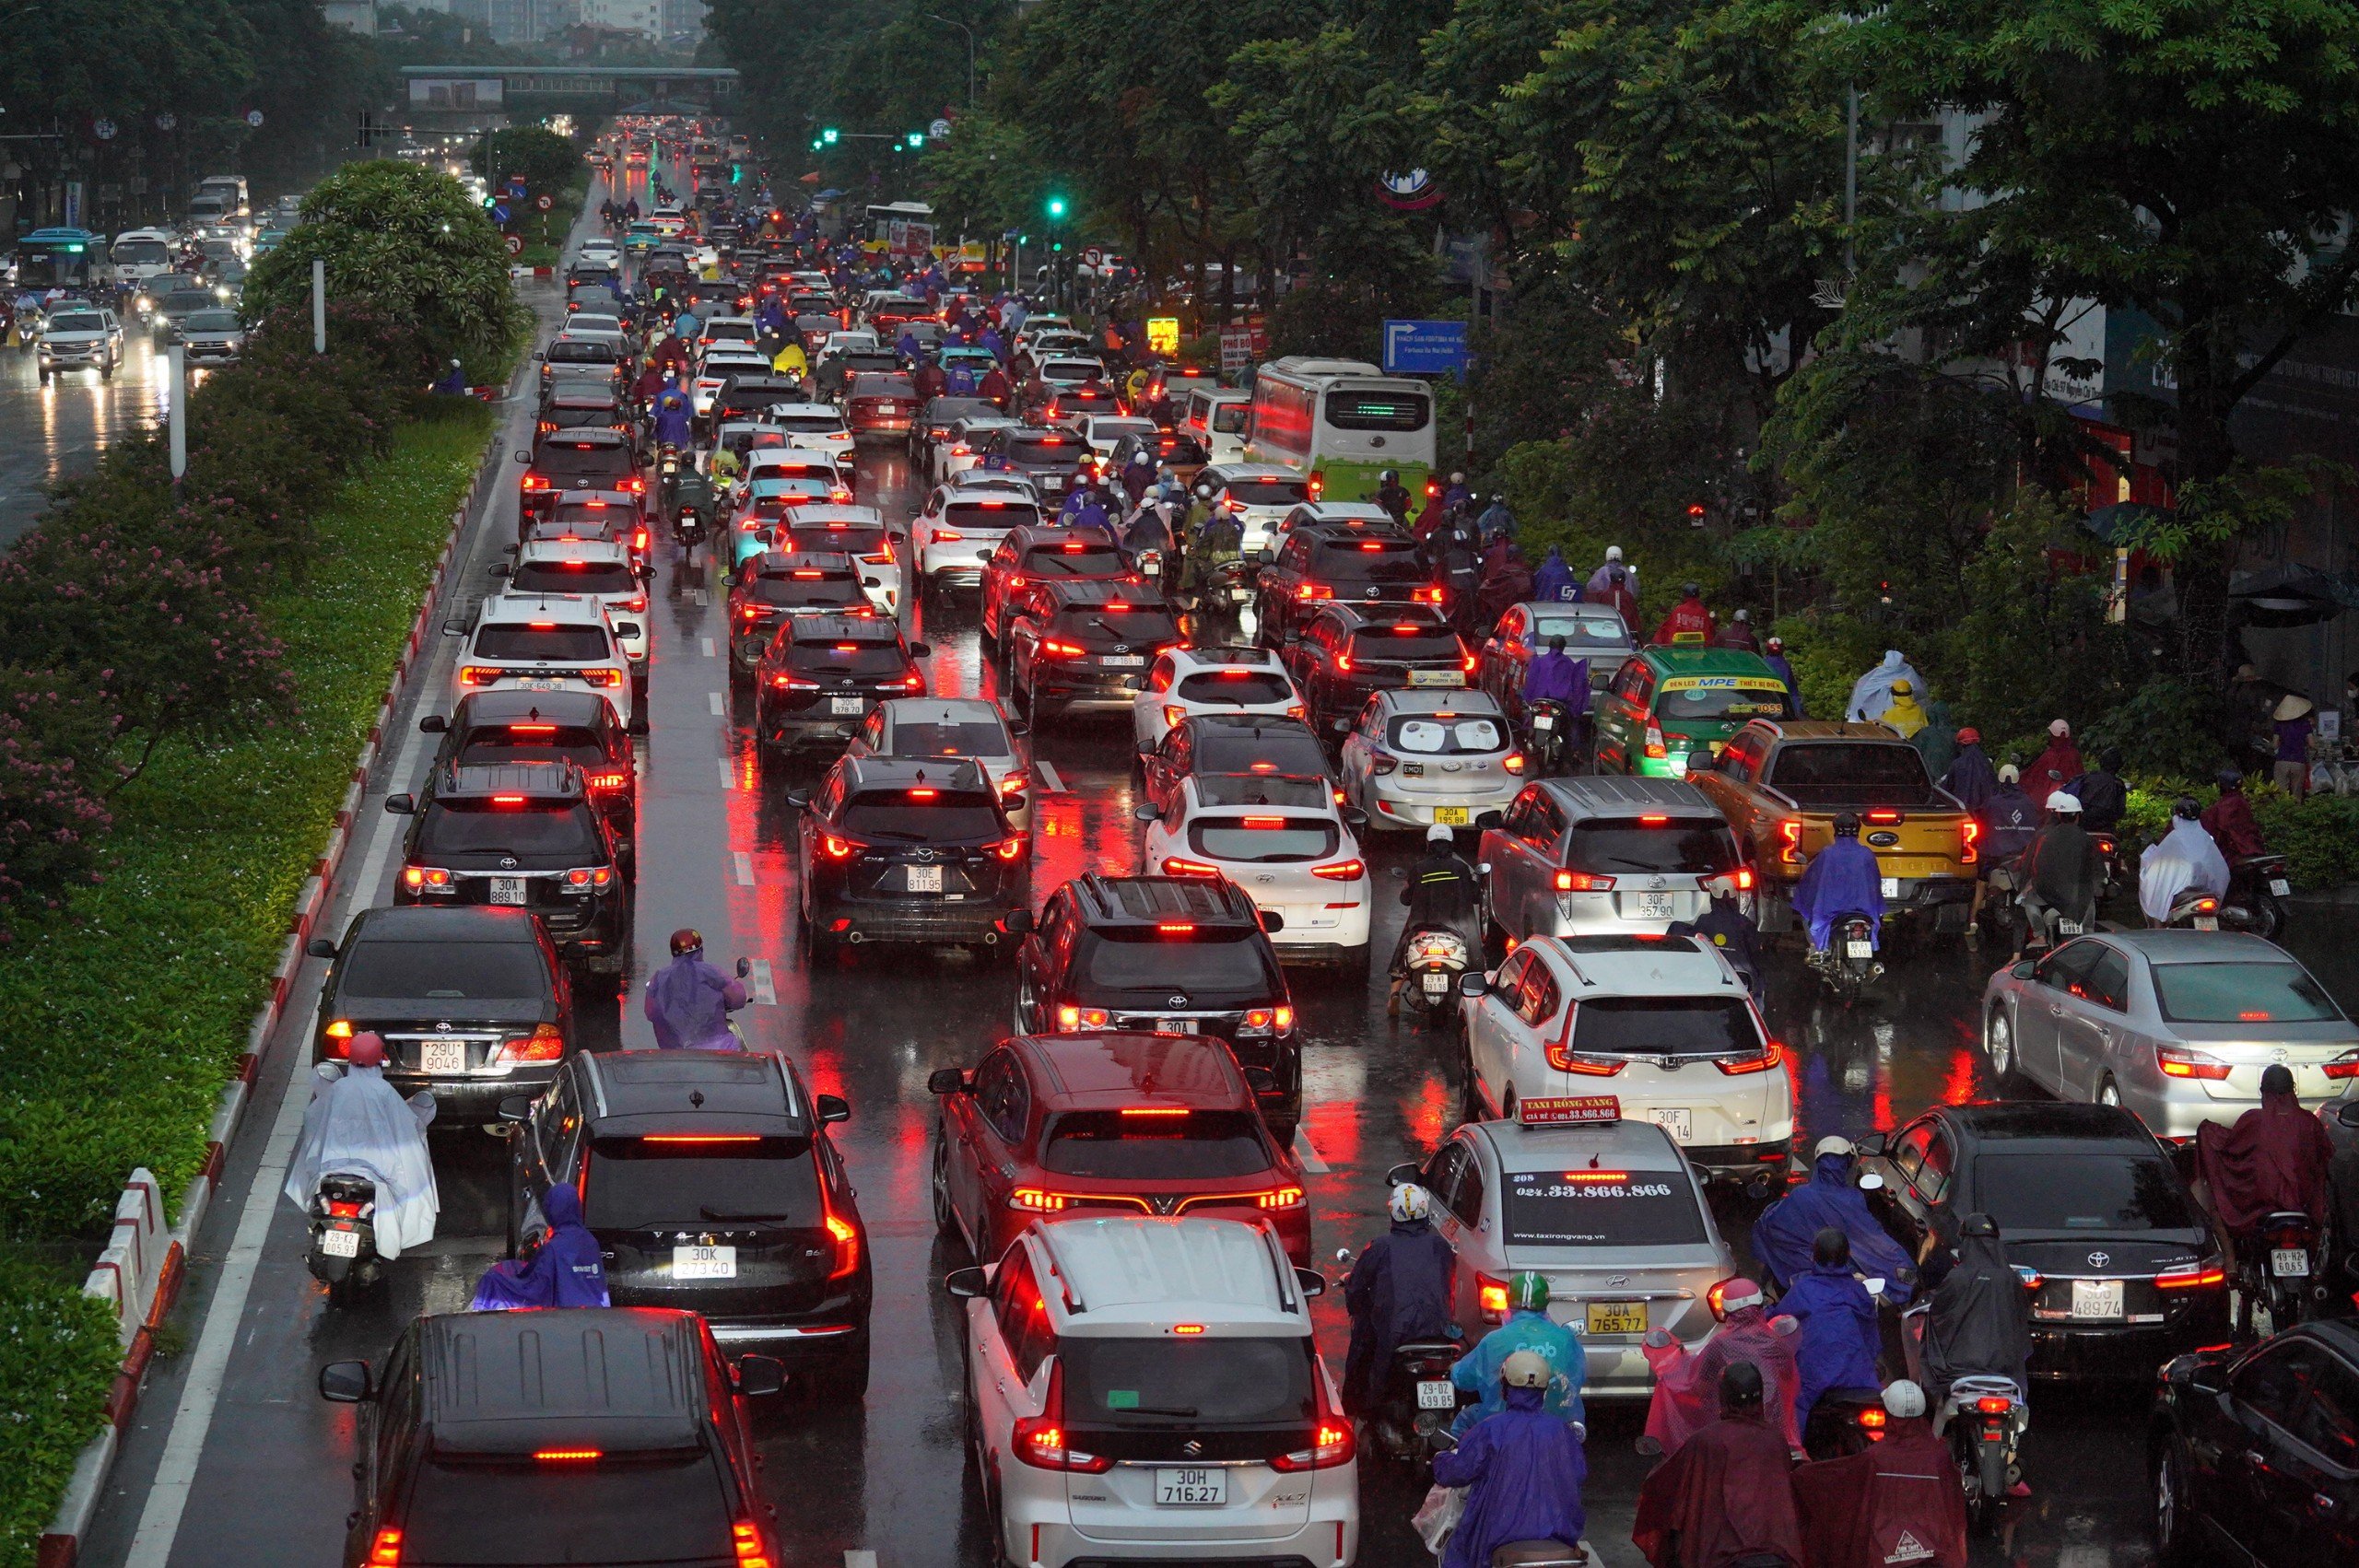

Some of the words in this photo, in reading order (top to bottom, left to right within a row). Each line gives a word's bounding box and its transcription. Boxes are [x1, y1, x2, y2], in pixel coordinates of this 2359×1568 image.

[1698, 678, 1738, 686] MPE
[1757, 704, 1782, 712] 1055
[1444, 808, 1459, 816] 30A
[916, 868, 933, 879] 30E
[499, 880, 518, 890] 30A
[909, 880, 941, 890] 811.95
[491, 891, 525, 902] 889.10
[1647, 895, 1664, 905] 30F
[1640, 906, 1672, 917] 357.90
[1426, 975, 1444, 983] 29-N1
[1168, 1022, 1188, 1034] 30A
[431, 1044, 454, 1056] 29U
[427, 1057, 459, 1070] 9046
[1525, 1101, 1550, 1109] TAXI
[1585, 1098, 1614, 1107] VÀNG
[1659, 1111, 1681, 1123] 30F
[1516, 1185, 1671, 1198] 024.33.866.866
[330, 1232, 354, 1245] 29-K2
[1513, 1232, 1605, 1241] www.taxirongvang.vn
[325, 1242, 355, 1255] 005.93
[692, 1248, 718, 1260] 30K
[682, 1263, 729, 1275] 273.40
[1604, 1305, 1630, 1316] 30A
[2074, 1300, 2120, 1316] 489.74
[1594, 1318, 1641, 1331] 765.77
[1423, 1384, 1449, 1395] 29-D2
[1421, 1395, 1452, 1407] 499.85
[1177, 1469, 1206, 1485] 30H
[1164, 1487, 1219, 1502] 716.27
